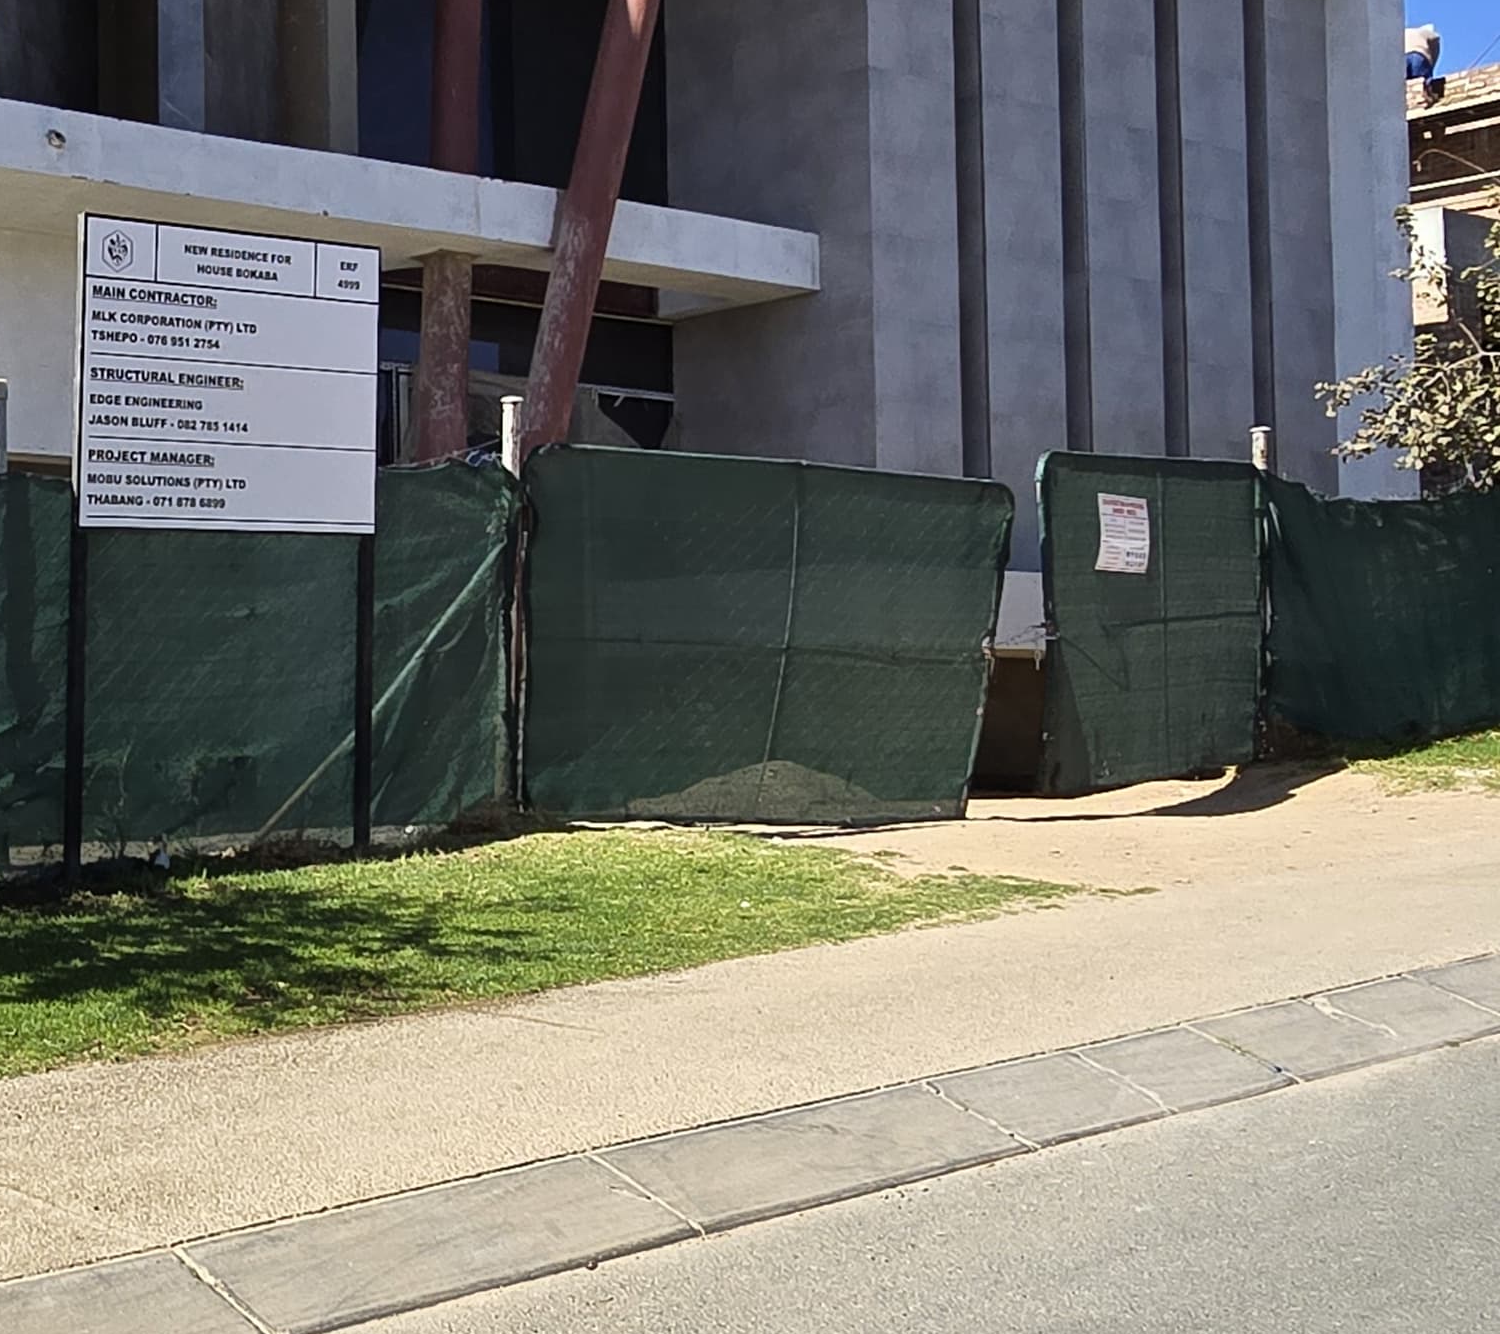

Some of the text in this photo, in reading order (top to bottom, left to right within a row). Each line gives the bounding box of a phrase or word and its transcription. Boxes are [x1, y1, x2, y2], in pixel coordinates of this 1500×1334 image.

[184, 244, 292, 266] NEW RESIDENCE FOR
[196, 263, 233, 278] HOUSE
[93, 285, 218, 309] MAIN CONTRACTOR:
[91, 309, 257, 335] MLK CORPORATION (PTY) LTD
[91, 329, 138, 344] TSHEPO
[91, 367, 244, 390] STRUCTURAL ENGINEER:
[89, 393, 203, 411] EDGE ENGINEERING
[88, 414, 129, 427] JASON
[131, 416, 168, 429] BLUFF
[222, 421, 249, 433] 1414
[88, 449, 214, 467] PROJECT MANAGER:
[124, 474, 191, 488] SOLUTIONS
[192, 477, 224, 491] (PTY)
[225, 478, 247, 490] LTD
[86, 493, 144, 507] THABANG
[152, 495, 173, 508] 071
